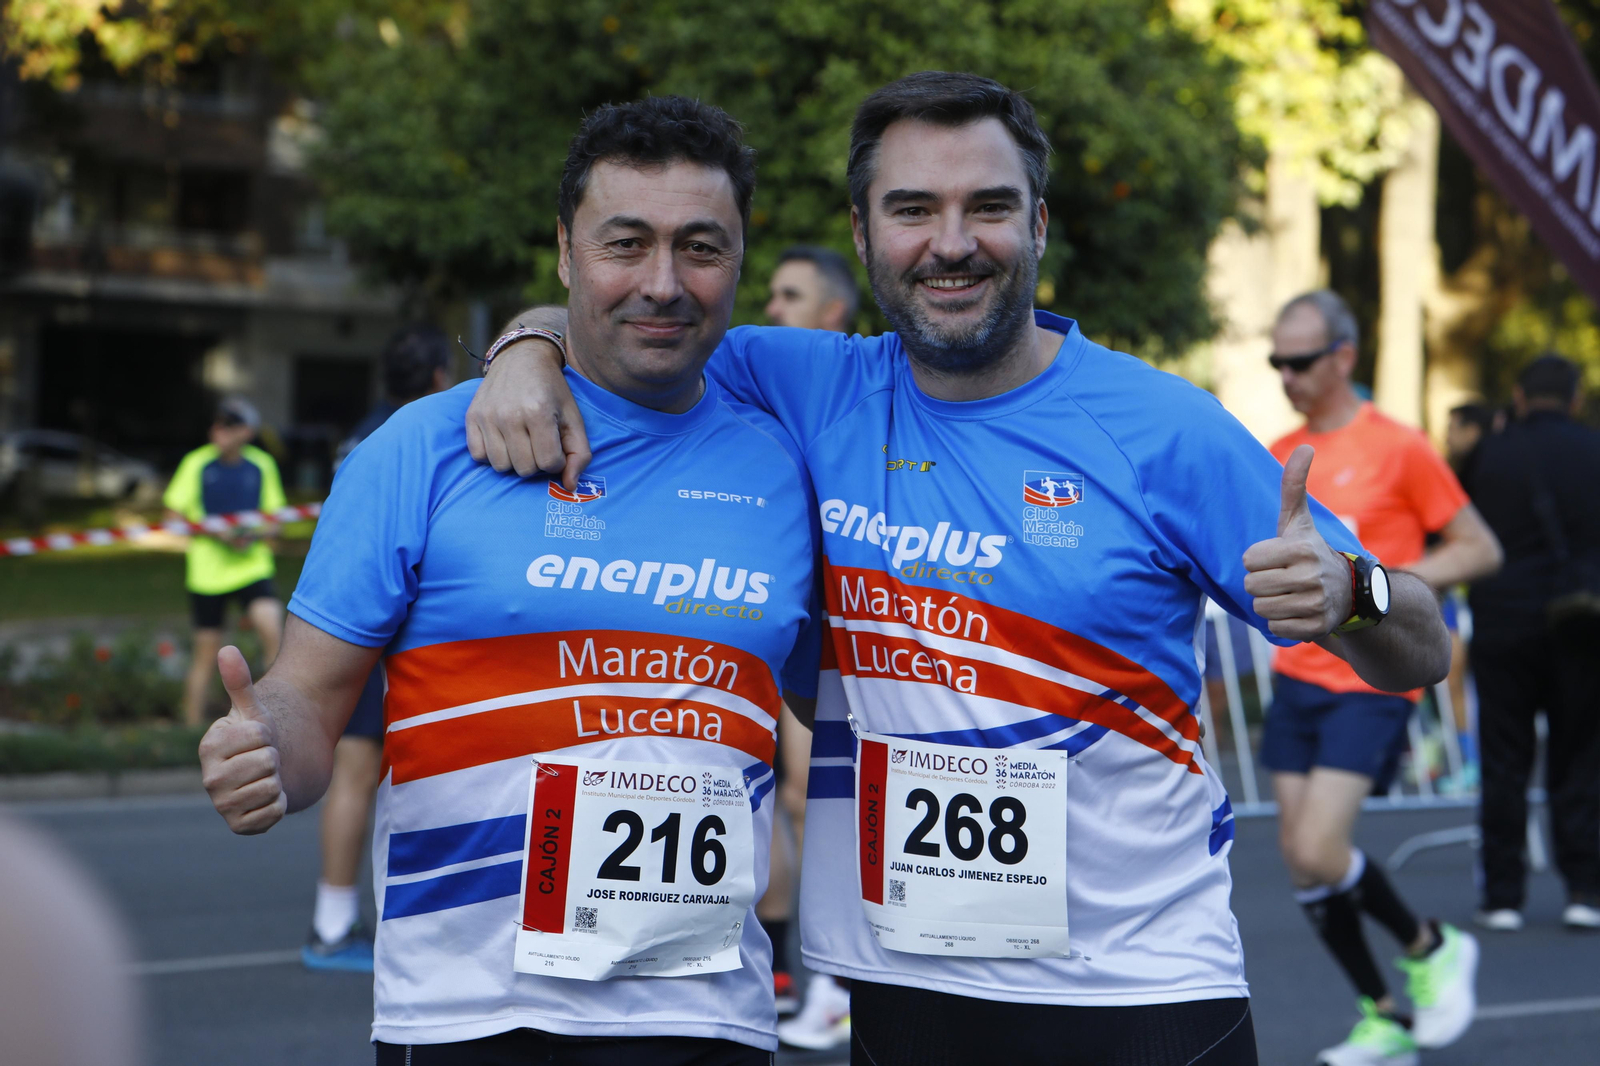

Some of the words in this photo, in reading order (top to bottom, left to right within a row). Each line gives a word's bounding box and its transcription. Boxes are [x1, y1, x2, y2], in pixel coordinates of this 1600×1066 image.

[678, 489, 753, 504] GSPORT
[547, 500, 582, 514] Club
[1023, 506, 1058, 521] Club
[546, 512, 605, 529] Maratón
[1023, 519, 1083, 536] Maratón
[545, 524, 600, 540] Lucena
[820, 498, 1007, 570] enerplus
[1023, 531, 1078, 548] Lucena
[526, 554, 770, 606] enerplus
[902, 562, 993, 586] directo
[665, 598, 763, 621] directo
[841, 576, 988, 642] Maratón
[558, 638, 738, 690] Maratón
[851, 634, 978, 694] Lucena
[573, 700, 722, 742] Lucena
[910, 750, 988, 775] IMDECO
[1010, 762, 1038, 770] MEDIA
[908, 770, 930, 779] Municipal
[940, 775, 963, 783] Deportes
[964, 777, 987, 785] Córdoba
[996, 769, 1007, 778] 36
[1010, 770, 1055, 780] MARATÓN
[610, 772, 696, 794] IMDECO
[702, 786, 712, 796] 36
[714, 780, 731, 788] MEDIA
[869, 783, 878, 794] 2
[1009, 780, 1040, 788] CÓRDOBA
[582, 790, 606, 798] Instituto
[608, 792, 636, 800] Municipal
[714, 788, 744, 798] MARATÓN
[546, 808, 561, 819] 2
[865, 800, 878, 865] CAJÓN
[903, 788, 1028, 865] 268
[597, 810, 727, 886] 216
[538, 826, 559, 894] CAJÓN
[890, 861, 913, 873] JUAN
[916, 865, 956, 878] CARLOS
[958, 869, 1003, 882] JIMENEZ
[1007, 873, 1047, 885] ESPEJO
[587, 888, 616, 900] JOSE
[619, 890, 680, 904] RODRIGUEZ
[683, 893, 730, 905] CARVAJAL
